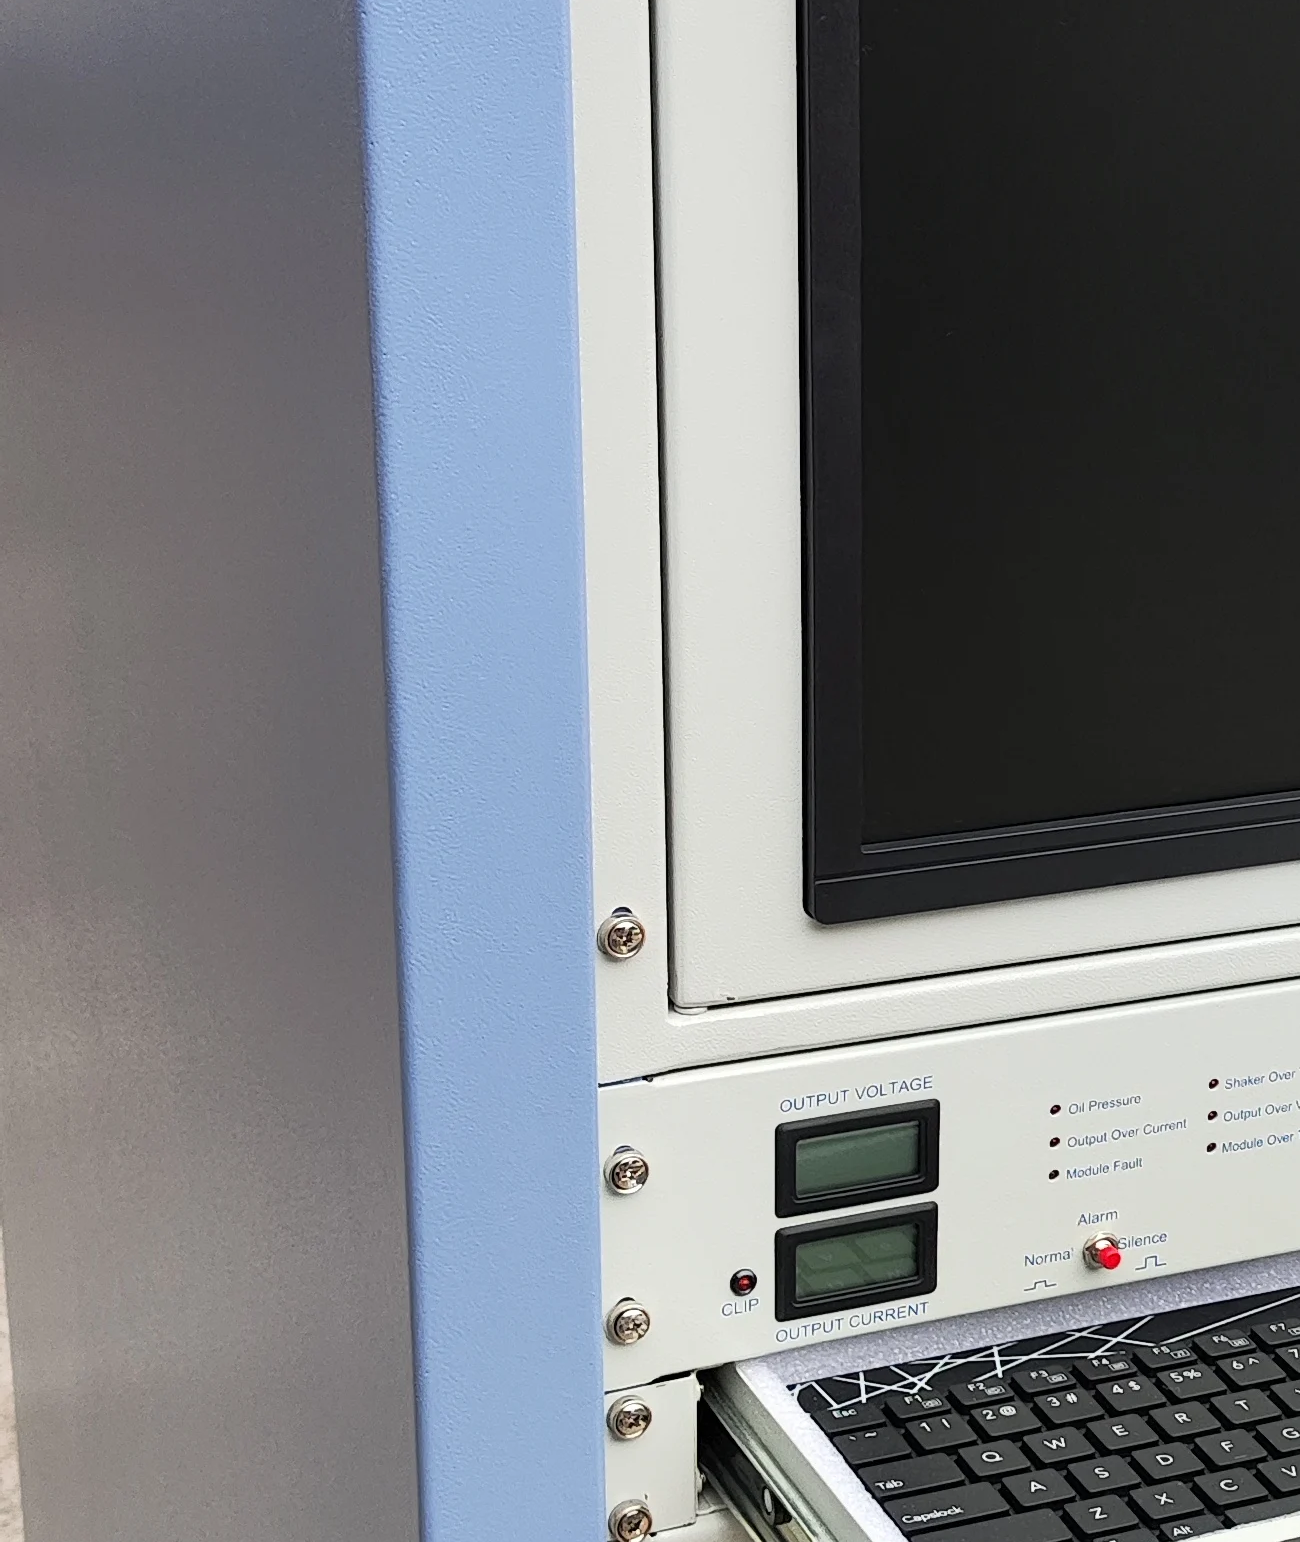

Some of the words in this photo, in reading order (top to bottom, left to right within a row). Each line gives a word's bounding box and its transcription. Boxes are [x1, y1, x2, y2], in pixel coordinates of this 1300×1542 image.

[1224, 1075, 1265, 1090] Shaker
[1268, 1071, 1296, 1083] Over
[779, 1089, 850, 1113] OUTPUT
[855, 1075, 933, 1100] VOLTAGE
[1068, 1102, 1085, 1115] Oil
[1089, 1095, 1142, 1112] Pressure
[1223, 1107, 1261, 1122] Output
[1265, 1102, 1292, 1115] Over
[1067, 1132, 1107, 1148] Output
[1111, 1128, 1140, 1141] Over
[1143, 1119, 1187, 1135] Current
[1222, 1137, 1263, 1153] Module
[1267, 1133, 1294, 1146] Over
[1066, 1163, 1109, 1180] Module
[1113, 1157, 1143, 1172] Fault
[1077, 1210, 1118, 1226] Alarm
[1117, 1232, 1168, 1250] Silence
[721, 1298, 759, 1317] CLIP
[775, 1317, 844, 1343] OUTPUT
[849, 1301, 929, 1328] CURRENT
[968, 1382, 985, 1392] F2
[1234, 1399, 1250, 1411] T
[832, 1407, 858, 1419] Esc
[1174, 1412, 1192, 1424] R
[1111, 1424, 1129, 1437] E
[1281, 1427, 1300, 1439] G
[1042, 1436, 1066, 1450] W
[1220, 1440, 1235, 1452] F
[981, 1451, 1003, 1463] Q
[1156, 1454, 1174, 1466] D
[1094, 1467, 1110, 1479] S
[1281, 1465, 1297, 1477] V
[876, 1479, 904, 1491] Tab
[1029, 1481, 1048, 1493] A
[1219, 1479, 1239, 1492] C
[1154, 1493, 1174, 1506] X
[902, 1506, 964, 1525] Capslock
[1088, 1506, 1108, 1520] Z
[1173, 1525, 1194, 1537] Alt
